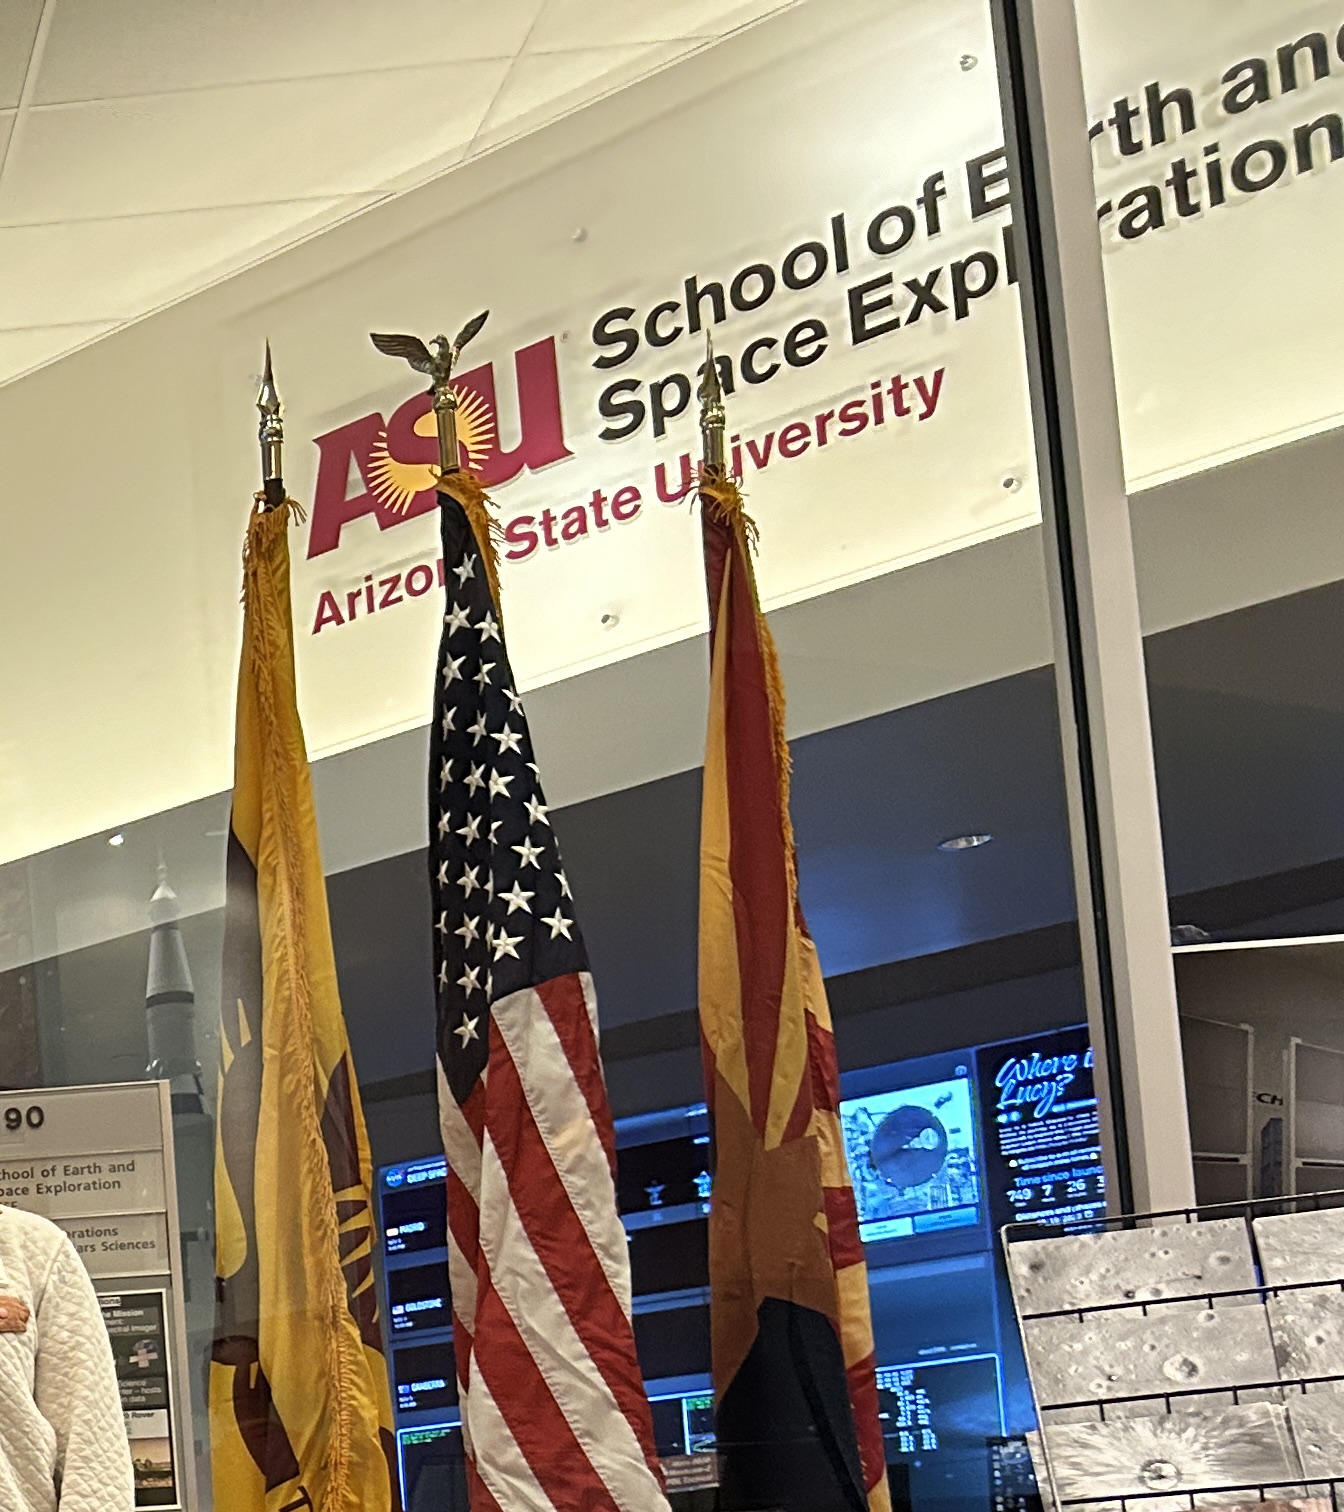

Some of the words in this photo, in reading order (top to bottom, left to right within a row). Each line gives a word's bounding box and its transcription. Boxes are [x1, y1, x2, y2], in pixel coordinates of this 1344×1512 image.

[591, 213, 849, 369] School
[867, 171, 947, 255] of
[966, 81, 1196, 222] Eth
[1221, 24, 1344, 115] an
[597, 318, 828, 440] Space
[848, 112, 1344, 346] Explation
[307, 336, 574, 560] ASU
[312, 557, 444, 636] Arizo
[505, 480, 640, 561] State
[654, 367, 945, 505] Uiversity
[995, 1052, 1077, 1087] Where
[1083, 1046, 1095, 1068] i
[996, 1073, 1075, 1118] Lucy?
[36, 1179, 122, 1197] Exploration
[41, 1164, 58, 1179] of
[63, 1162, 103, 1177] Earth
[108, 1160, 136, 1174] and
[101, 1238, 157, 1251] Sciences
